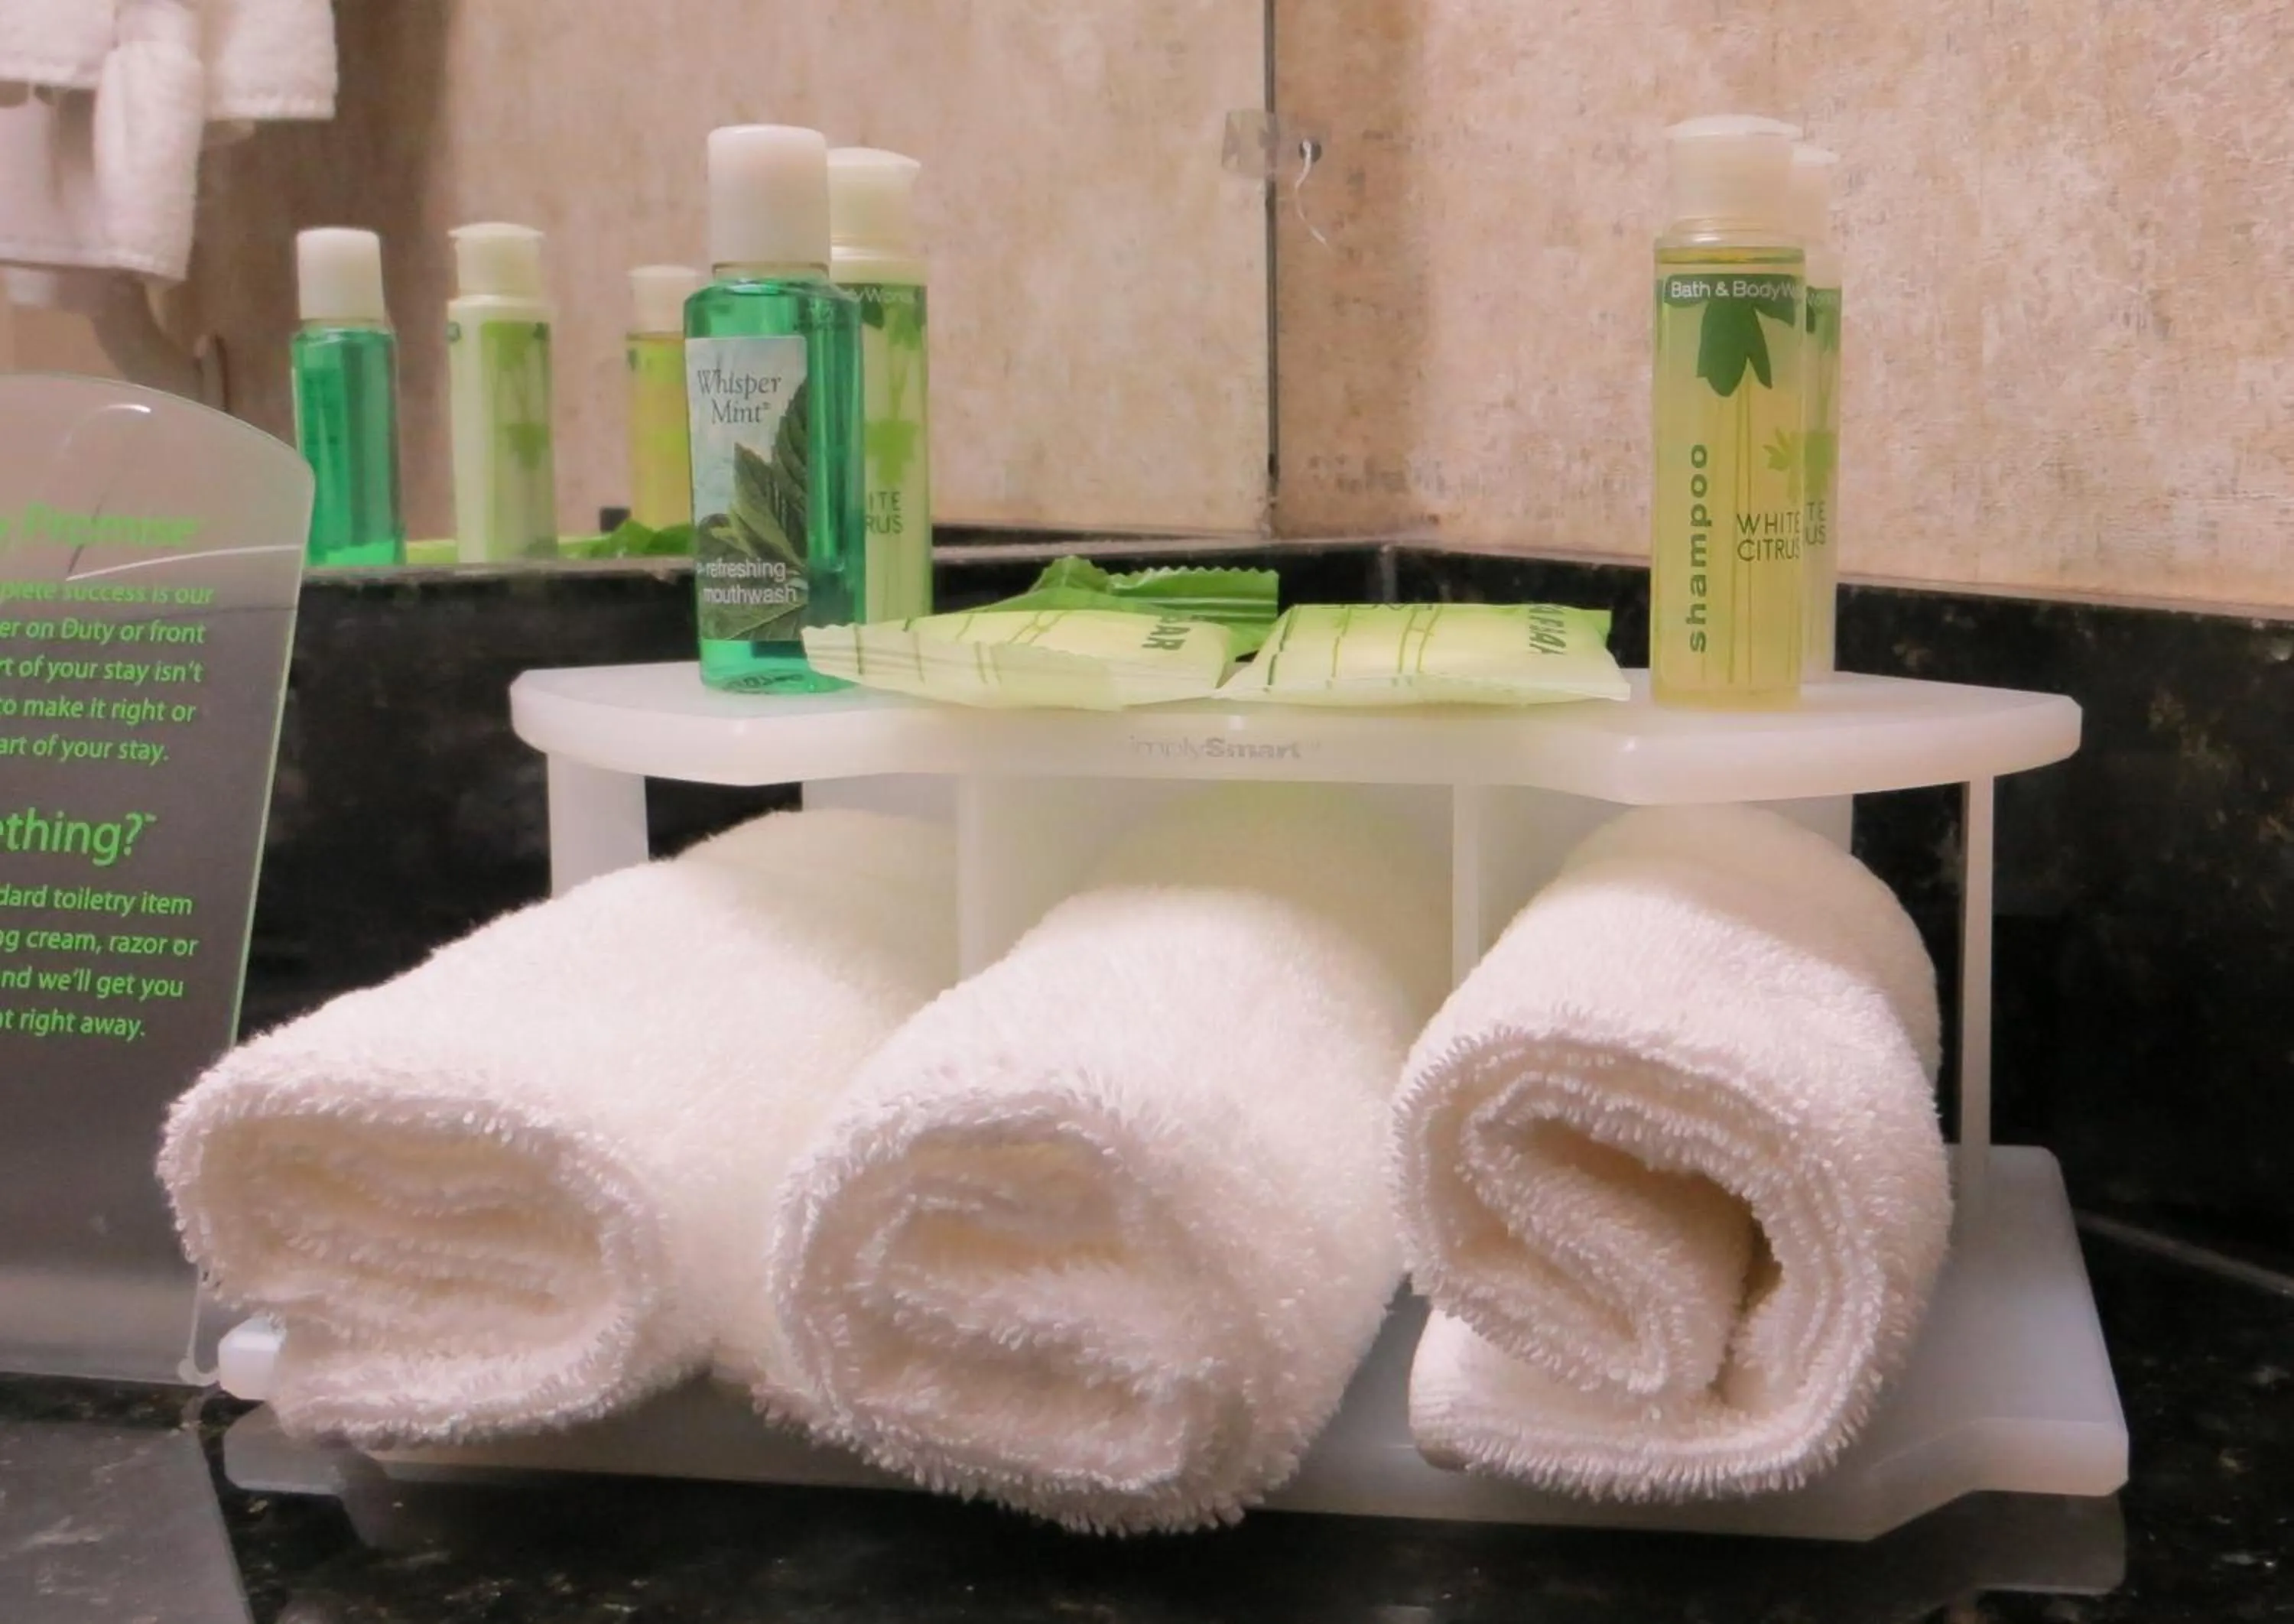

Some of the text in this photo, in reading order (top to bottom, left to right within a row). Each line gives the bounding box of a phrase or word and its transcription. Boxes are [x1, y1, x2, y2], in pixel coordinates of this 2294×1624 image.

[1671, 280, 1711, 299] Bath
[1715, 281, 1730, 297] &
[697, 364, 782, 401] Whisper
[1737, 511, 1800, 536] WHITE
[1685, 443, 1713, 654] shampoo
[705, 557, 786, 583] refreshing
[63, 585, 146, 603] success
[153, 585, 169, 603] is
[175, 587, 214, 605] our
[703, 583, 798, 604] mouthwash
[26, 622, 54, 640] on
[61, 617, 114, 646] Duty
[120, 623, 145, 641] or
[150, 619, 206, 645] front
[19, 654, 46, 677] of
[47, 661, 98, 683] your
[104, 661, 149, 684] stay
[155, 660, 204, 684] isn't
[23, 694, 84, 719] make
[90, 695, 106, 719] it
[112, 697, 165, 726] right
[171, 703, 197, 723] or
[33, 733, 60, 758] of
[60, 742, 113, 762] your
[119, 739, 170, 767] stay.
[0, 807, 145, 867] thing?
[54, 885, 137, 918] toiletry
[141, 891, 193, 916] item
[26, 931, 102, 955] cream,
[109, 934, 170, 956] razor
[173, 937, 200, 957] or
[38, 969, 92, 992] we'll
[96, 973, 136, 1000] get
[139, 976, 185, 1002] you
[20, 1008, 76, 1038] right
[80, 1015, 146, 1043] away.
